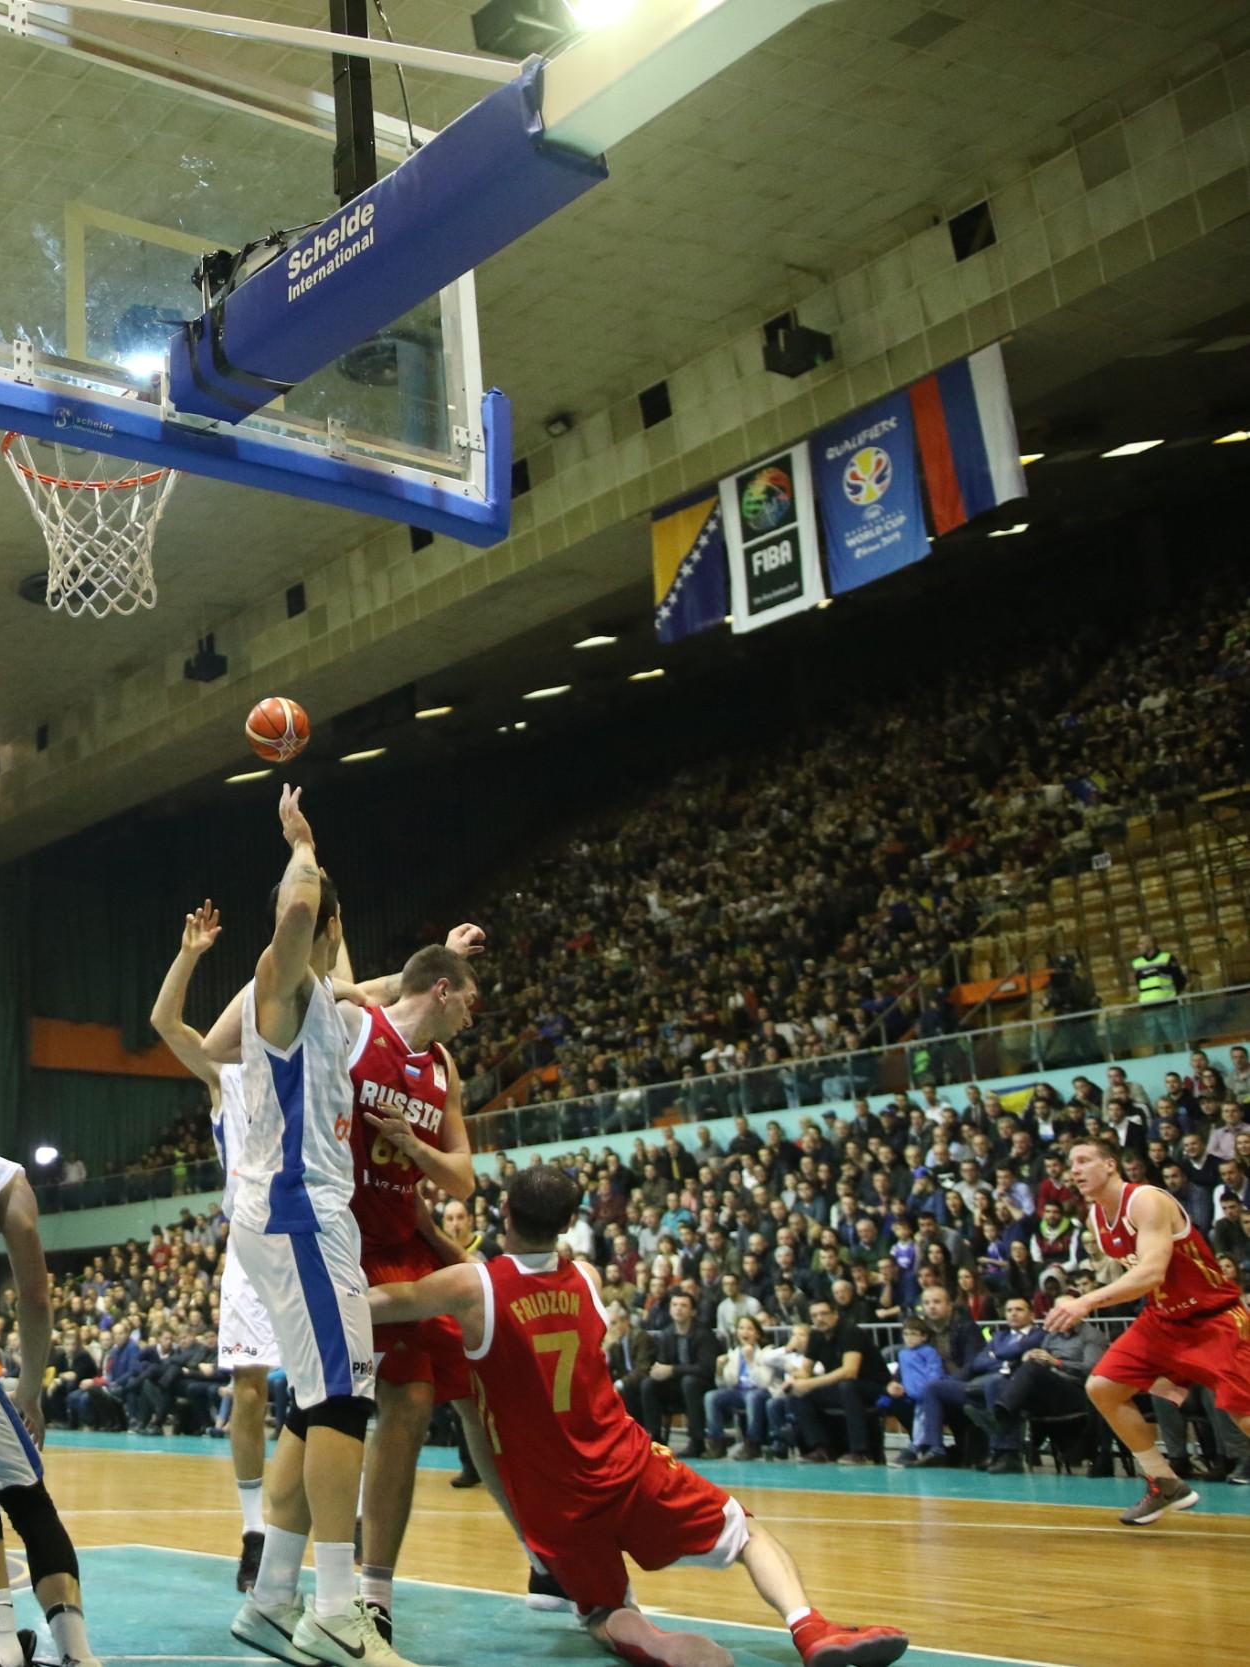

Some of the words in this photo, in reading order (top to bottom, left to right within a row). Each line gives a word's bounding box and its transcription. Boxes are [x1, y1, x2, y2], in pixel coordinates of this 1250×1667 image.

[287, 227, 375, 303] International
[288, 202, 375, 280] Schelde
[751, 540, 793, 576] FIBA
[845, 526, 884, 548] WORLD
[359, 1079, 443, 1134] RUSSIA
[509, 1290, 580, 1325] FRIDZON
[532, 1329, 580, 1413] 7
